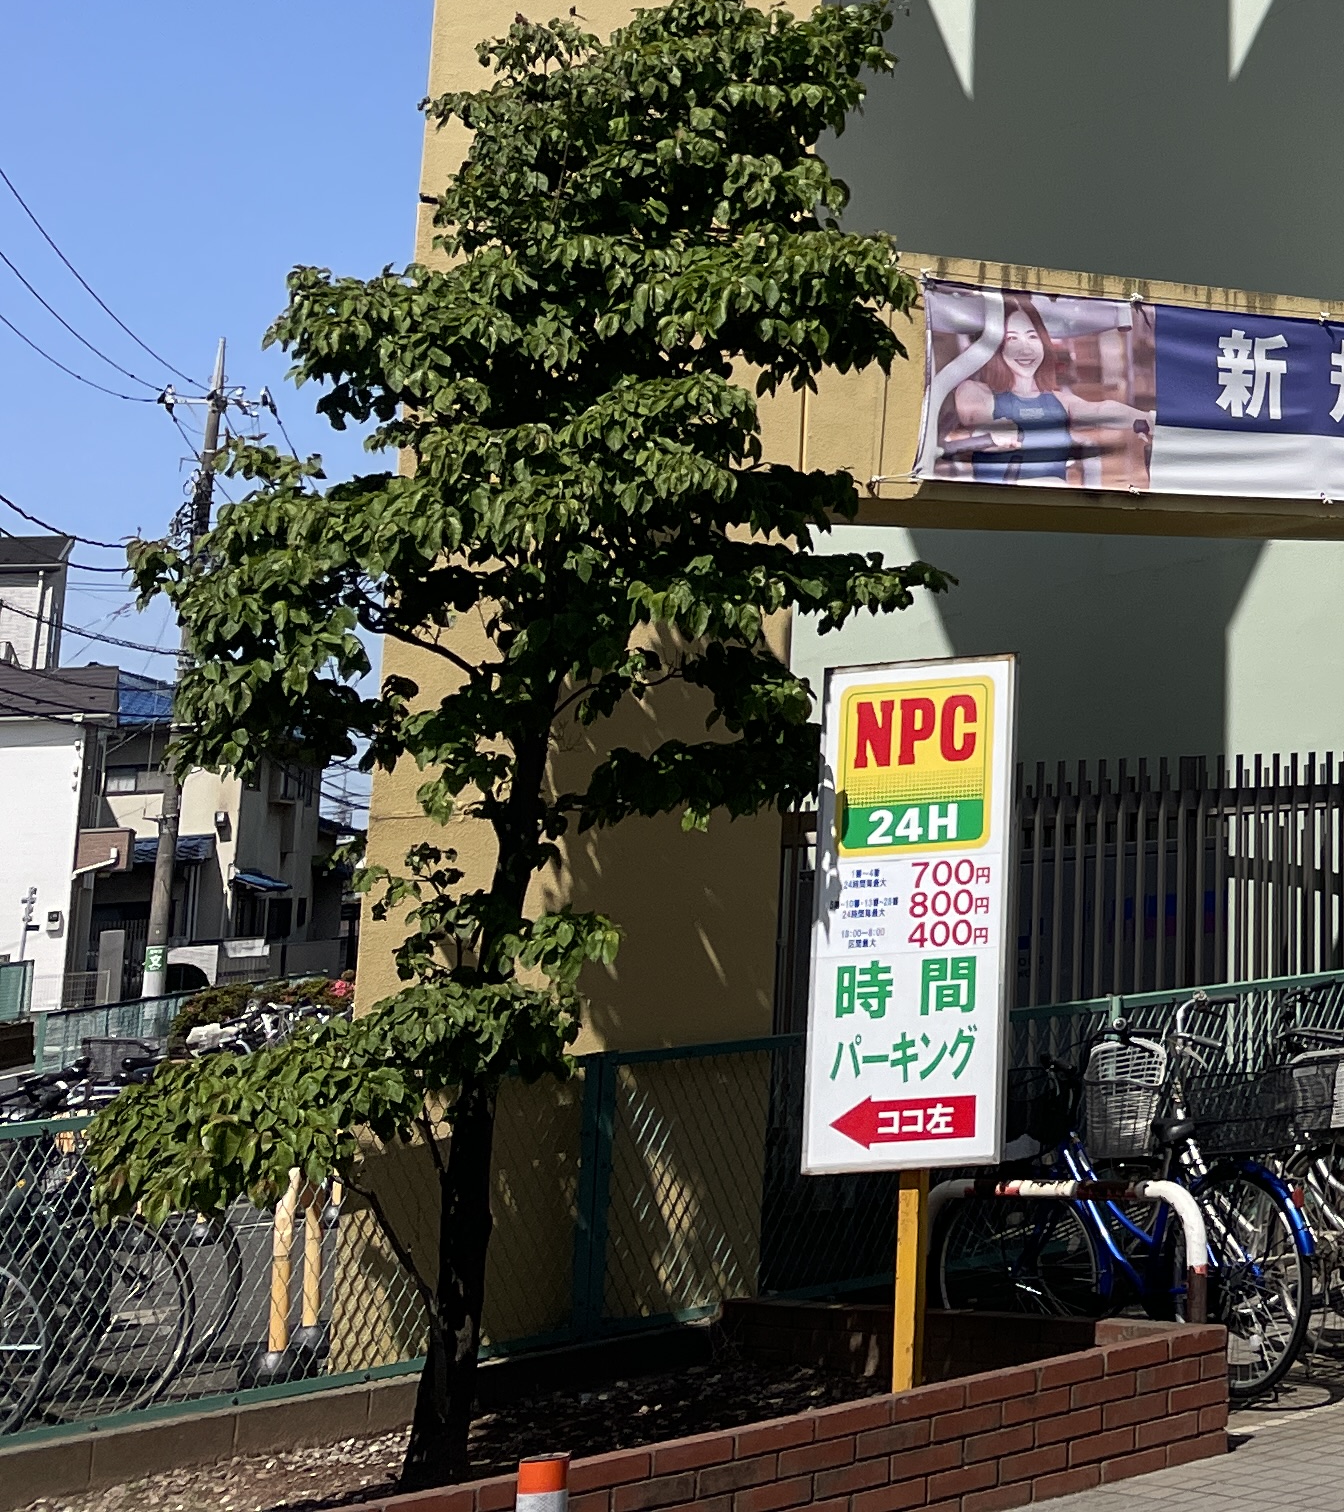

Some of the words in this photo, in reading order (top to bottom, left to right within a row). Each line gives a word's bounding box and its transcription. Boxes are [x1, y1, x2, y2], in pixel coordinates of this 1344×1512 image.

[853, 693, 978, 770] NPC
[866, 803, 960, 847] 24H
[911, 858, 991, 889] 700円
[909, 888, 989, 918] 800円
[907, 919, 989, 948] 400円
[835, 955, 977, 1020] 時間
[830, 1024, 978, 1084] パーキング
[876, 1102, 955, 1137] ココ左
